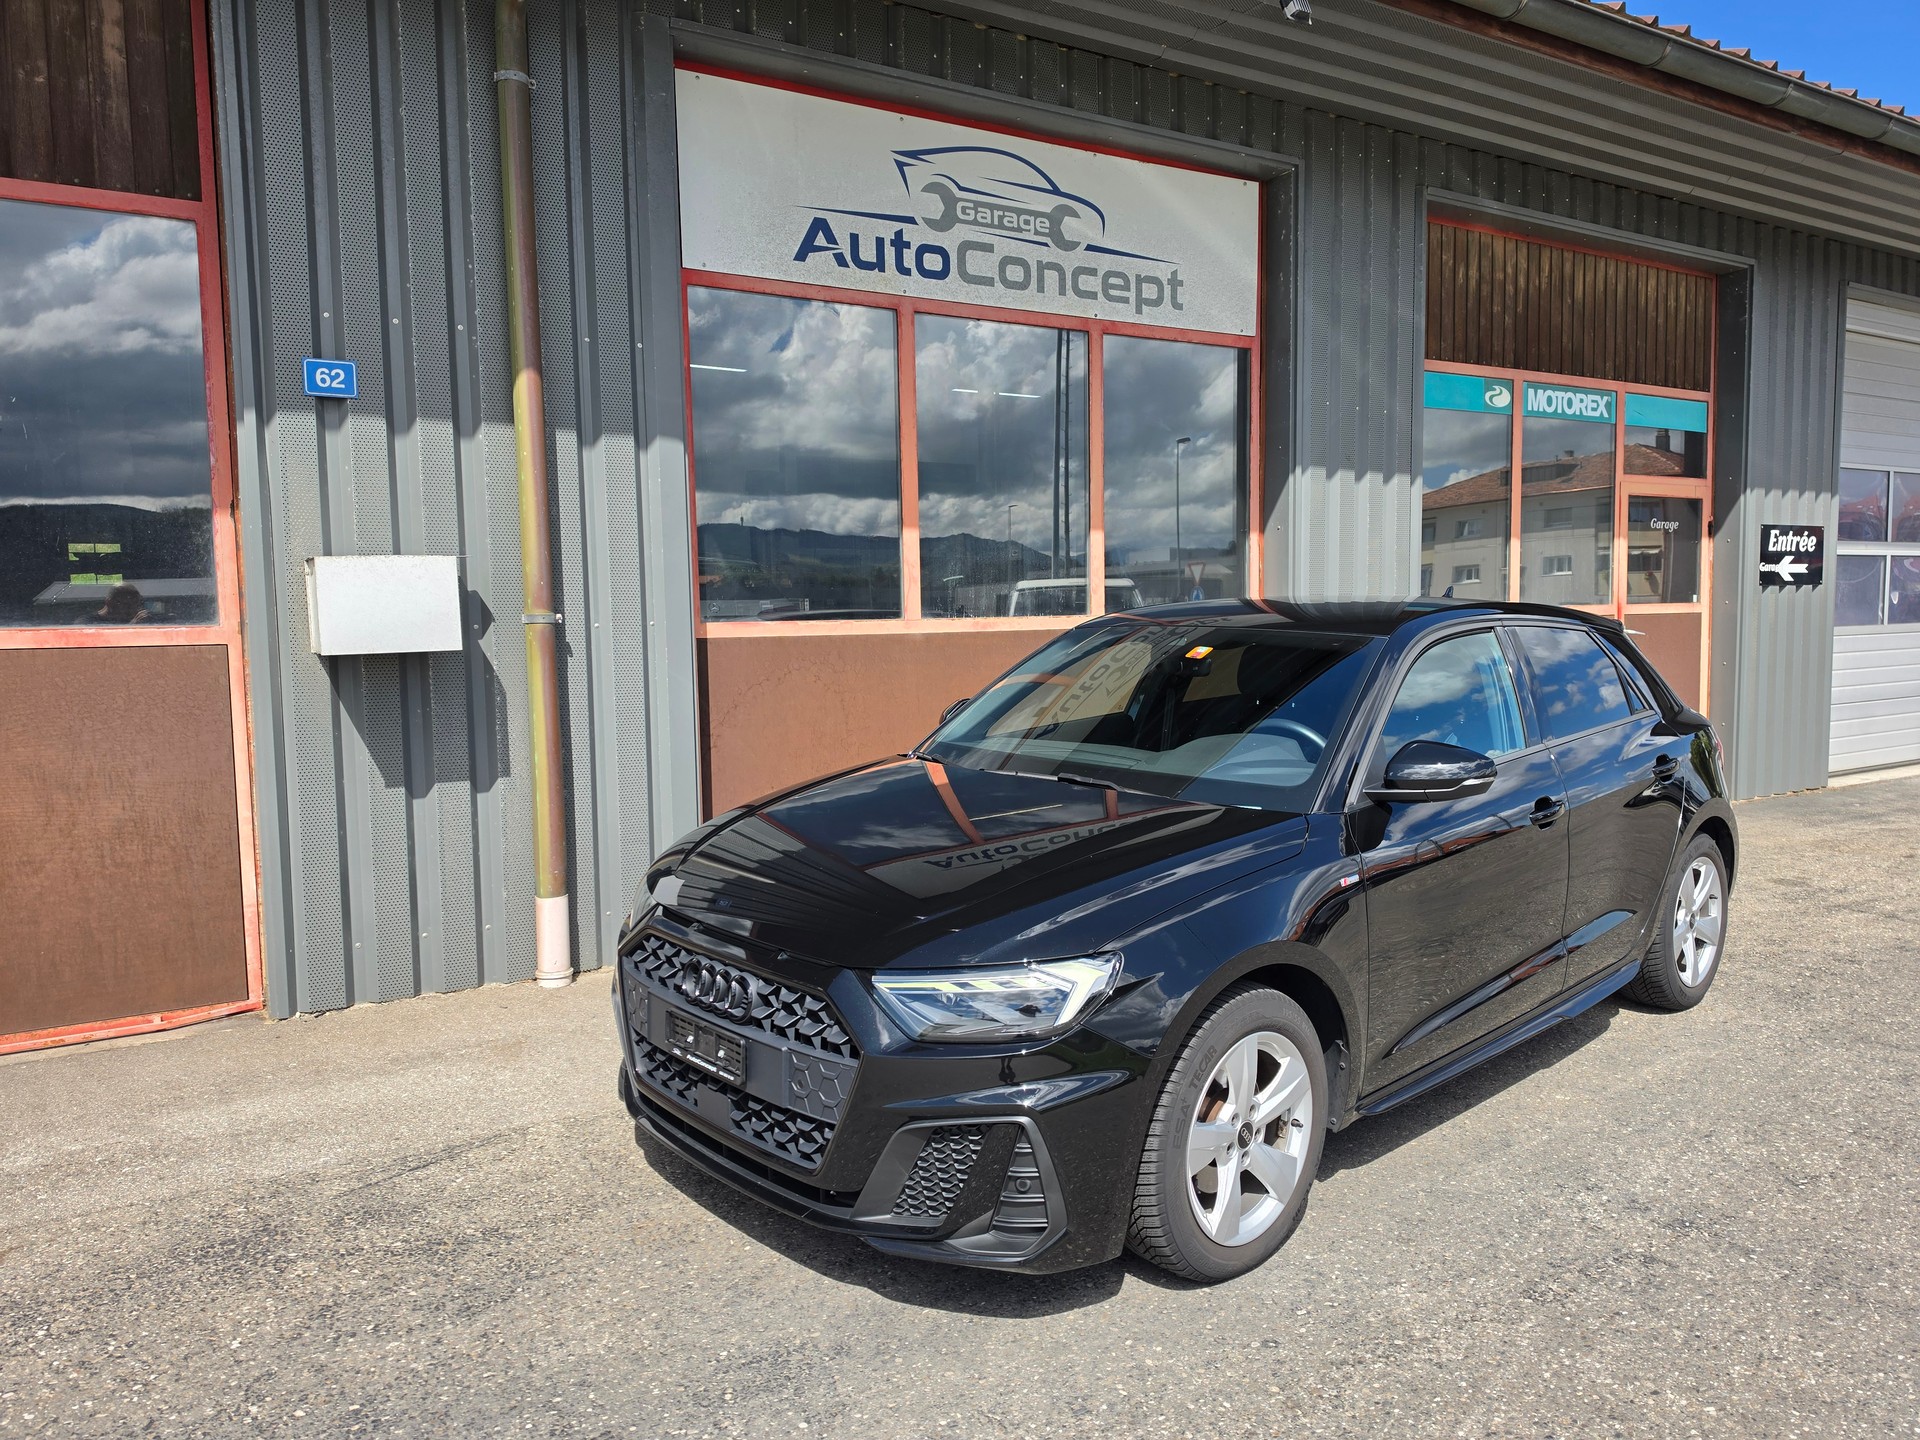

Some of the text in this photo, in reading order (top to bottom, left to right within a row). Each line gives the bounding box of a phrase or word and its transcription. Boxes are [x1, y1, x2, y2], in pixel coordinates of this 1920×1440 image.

[956, 201, 1050, 236] Garage
[793, 217, 1184, 315] AutoConcept
[315, 367, 346, 389] 62
[1527, 388, 1609, 418] MOTOREX
[1650, 517, 1679, 533] Garage
[1768, 529, 1817, 552] Entrée
